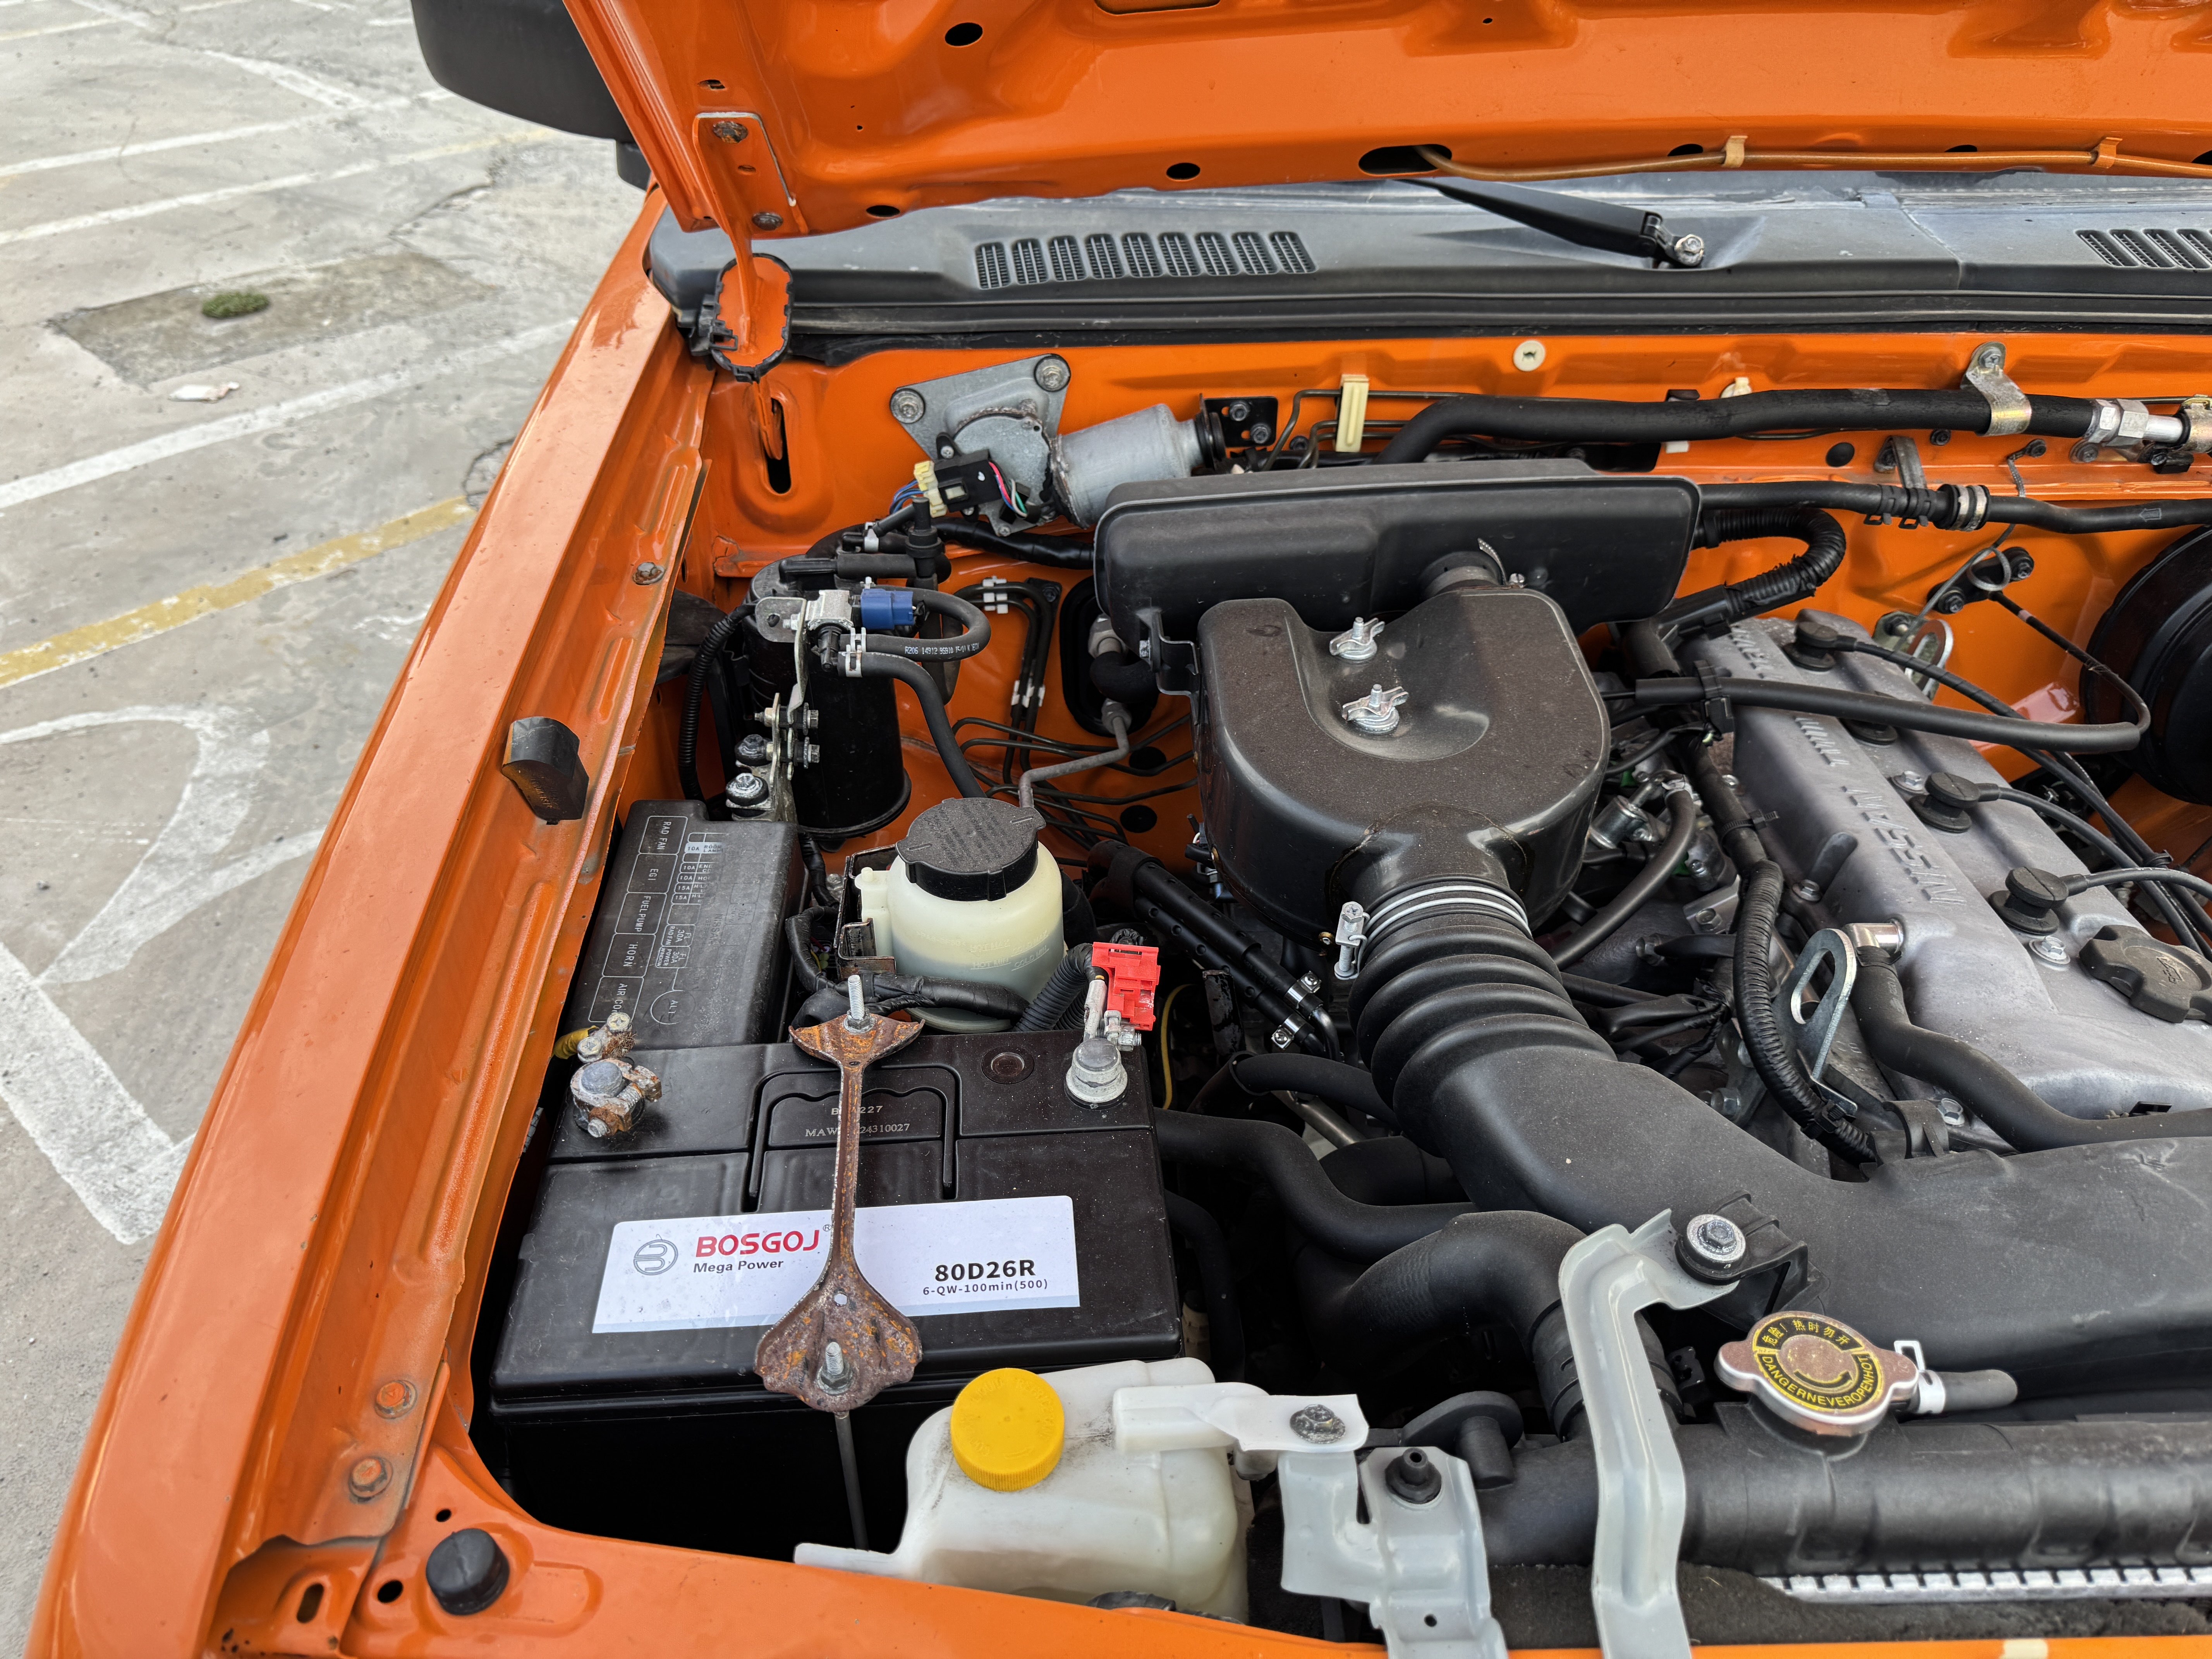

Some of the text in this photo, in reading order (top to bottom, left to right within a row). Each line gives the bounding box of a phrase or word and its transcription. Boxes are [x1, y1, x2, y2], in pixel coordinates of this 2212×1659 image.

[657, 821, 672, 850] RAD FAN
[1841, 786, 1966, 904] NISSAN
[647, 869, 659, 880] EGI
[675, 929, 685, 943] 30A
[623, 944, 639, 967] HORN
[663, 949, 672, 966] POWER
[670, 951, 680, 963] 30A
[616, 983, 628, 996] AIR
[696, 1229, 820, 1257] BOSGOJ
[693, 1261, 784, 1274] Mega Power
[935, 1259, 1036, 1282] 80D26R
[923, 1279, 1048, 1296] 6-QW-100min(500)
